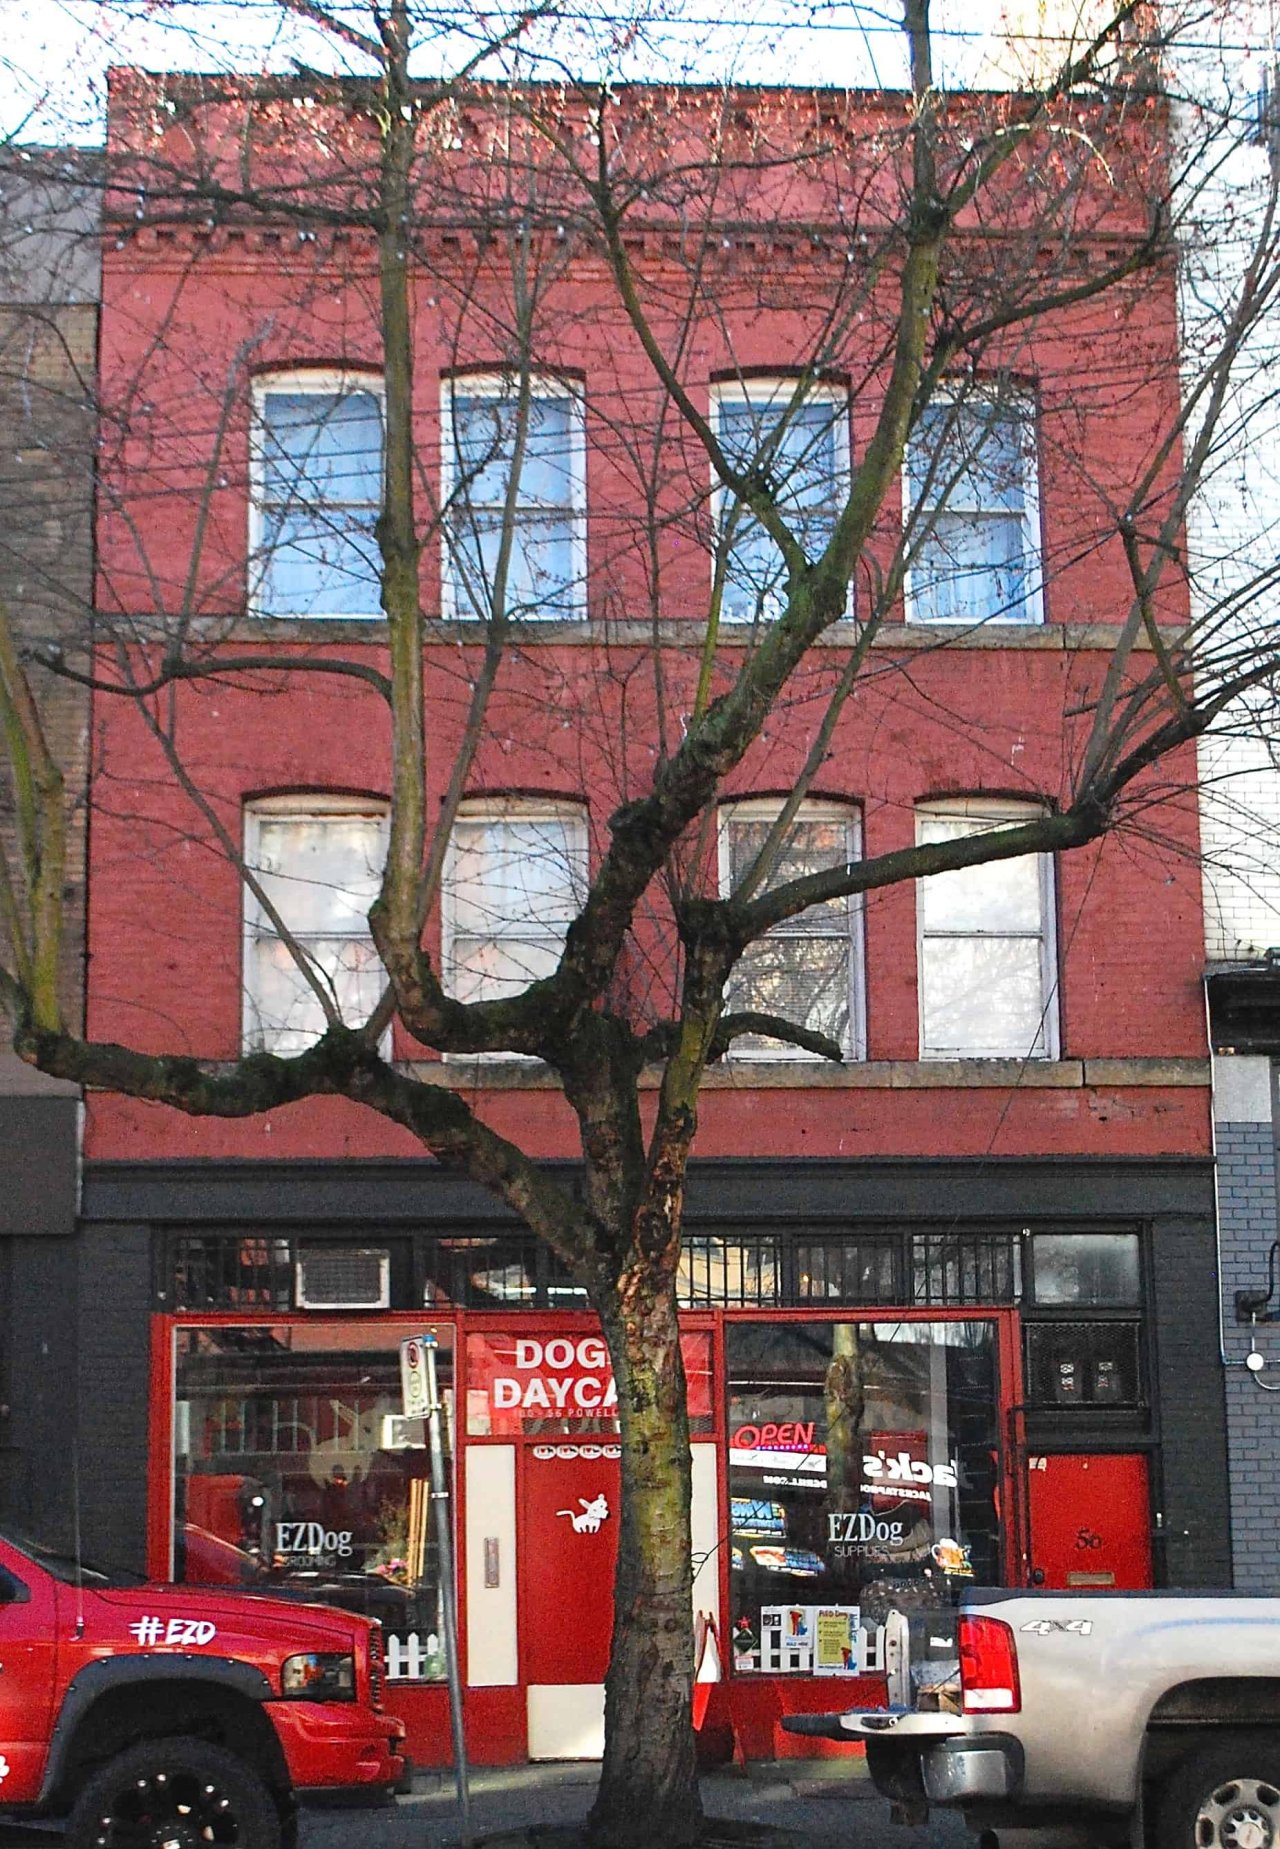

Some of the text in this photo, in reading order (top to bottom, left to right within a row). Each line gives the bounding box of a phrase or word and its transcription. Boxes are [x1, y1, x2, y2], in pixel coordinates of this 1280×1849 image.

[516, 1338, 611, 1369] DOG
[493, 1376, 619, 1408] DAYCA
[735, 1422, 815, 1450] OPEN
[275, 1522, 353, 1557] EZDog
[828, 1513, 904, 1546] EZDog
[834, 1545, 890, 1558] SUPPLIES
[128, 1615, 217, 1647] #EZD
